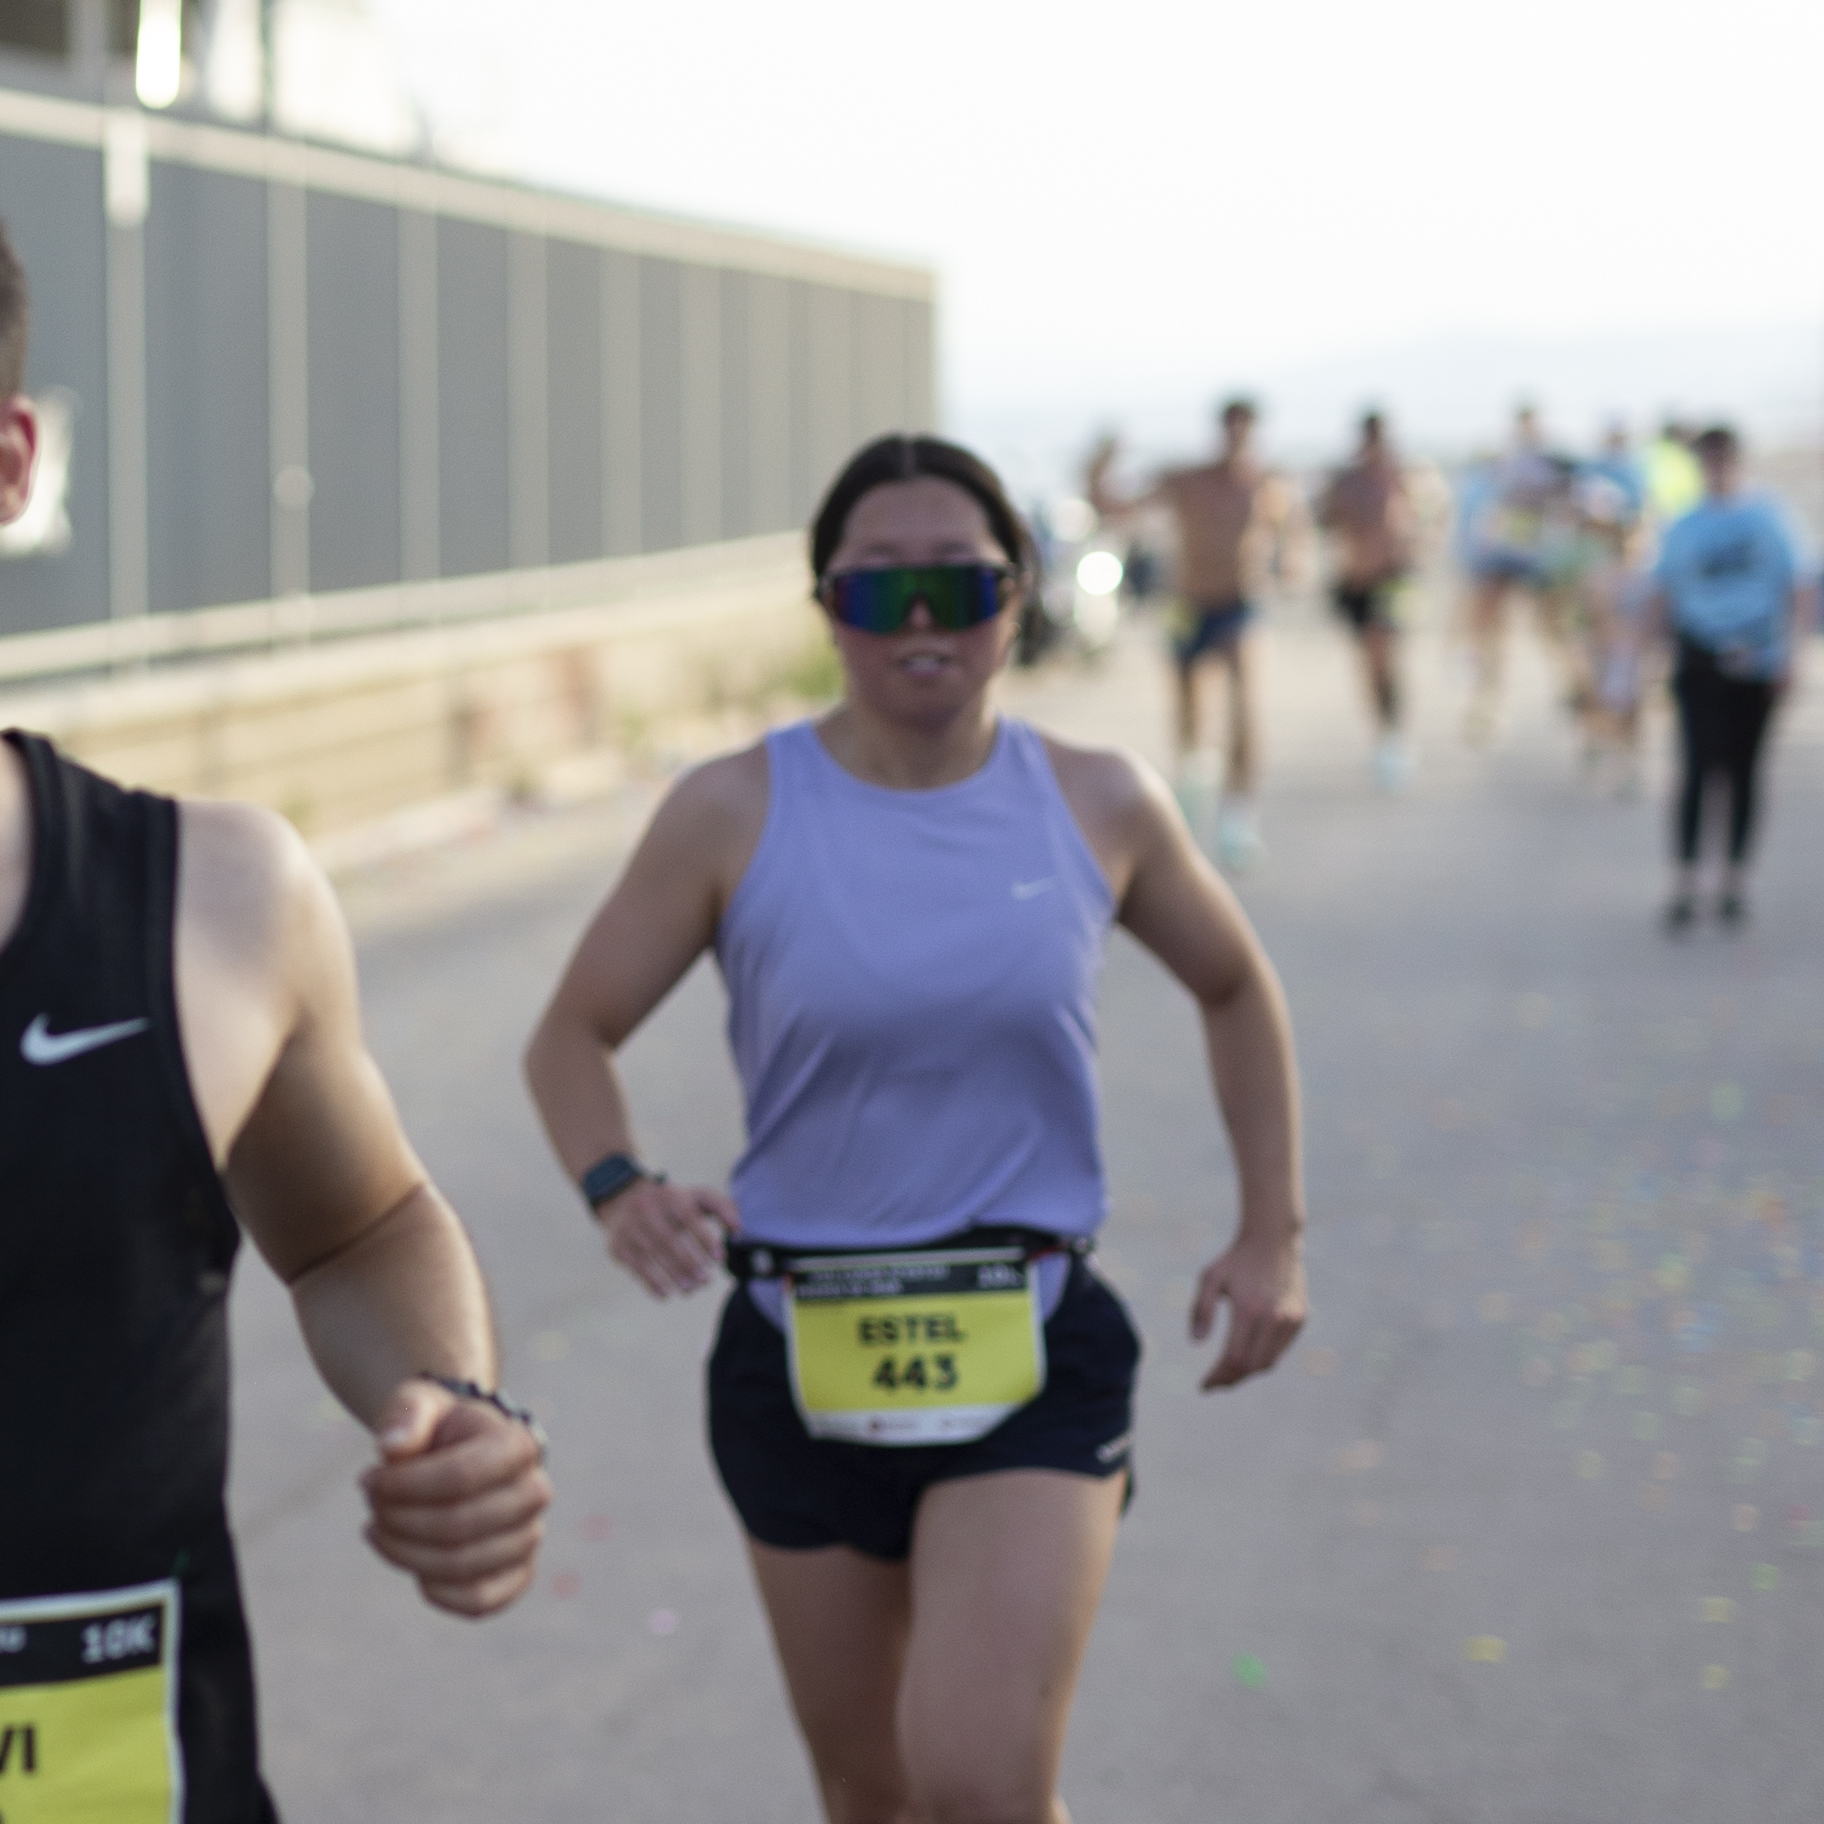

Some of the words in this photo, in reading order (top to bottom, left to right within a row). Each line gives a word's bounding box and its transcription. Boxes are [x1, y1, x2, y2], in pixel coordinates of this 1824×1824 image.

[858, 1316, 965, 1346] ESTEL
[873, 1354, 960, 1392] 443
[81, 1613, 157, 1664] 10K
